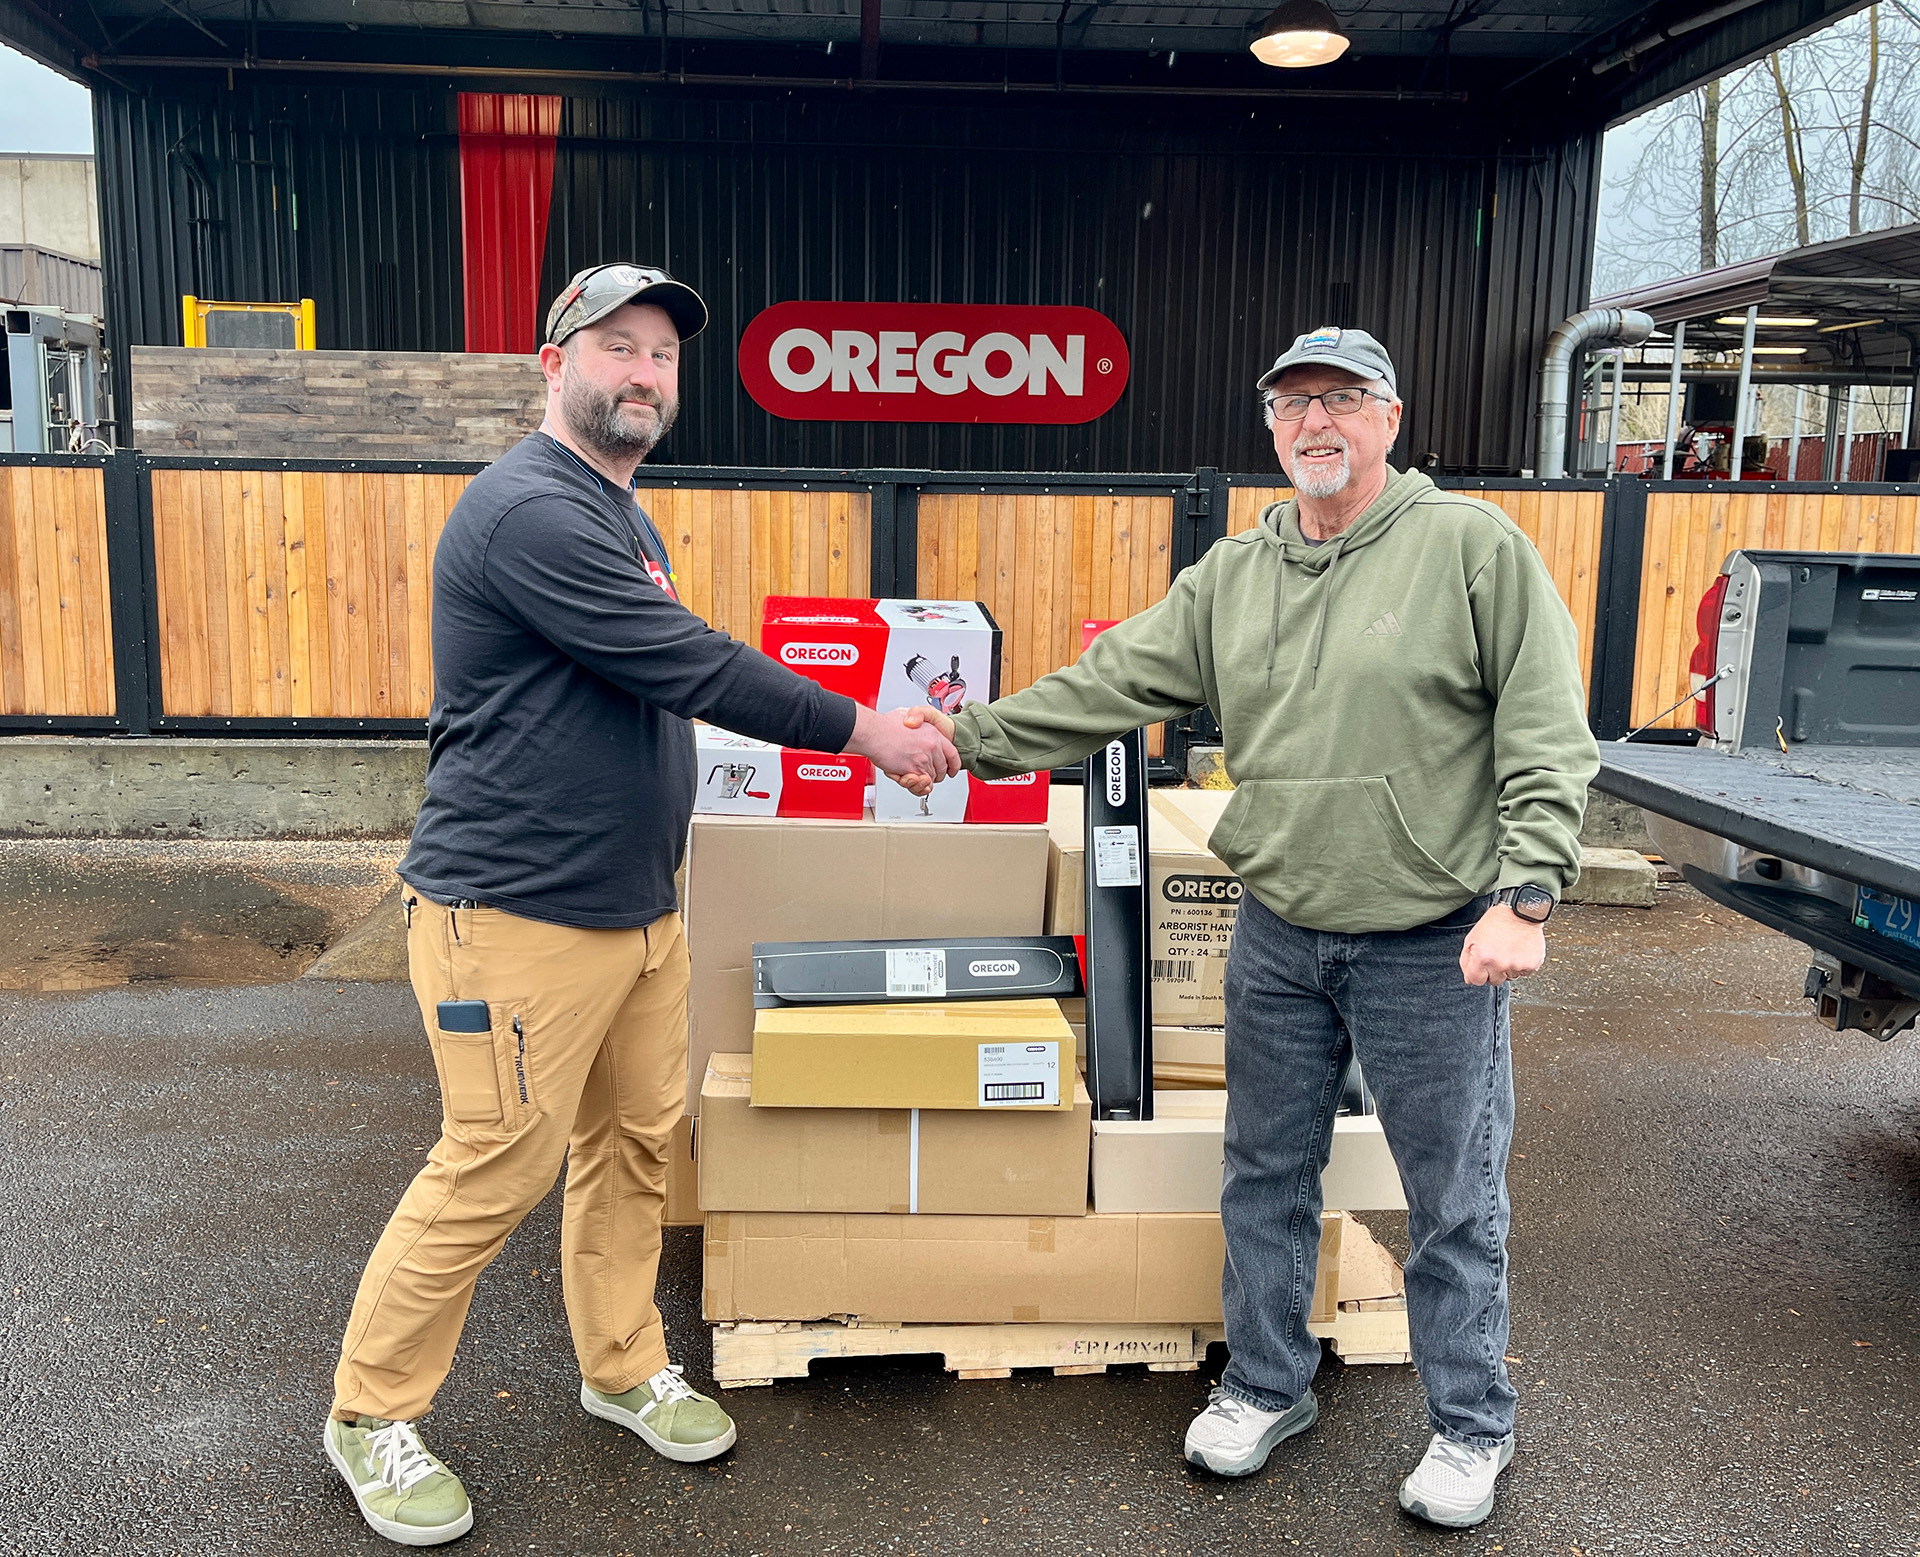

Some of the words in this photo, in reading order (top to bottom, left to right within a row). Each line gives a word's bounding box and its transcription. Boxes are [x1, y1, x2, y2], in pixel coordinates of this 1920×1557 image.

[768, 327, 1086, 396] OREGON
[785, 647, 852, 661] OREGON
[800, 767, 847, 779] OREGON
[1111, 746, 1121, 802] OREGON
[1159, 921, 1208, 931] ARBORIST
[1210, 923, 1235, 932] HAN
[1169, 932, 1213, 943] CURVED,
[1216, 934, 1228, 942] 13
[1168, 947, 1189, 956] QTY
[1197, 949, 1209, 957] 24
[972, 963, 1015, 973] OREGON
[1047, 1061, 1056, 1069] 12
[515, 1054, 528, 1104] TRUEWERK
